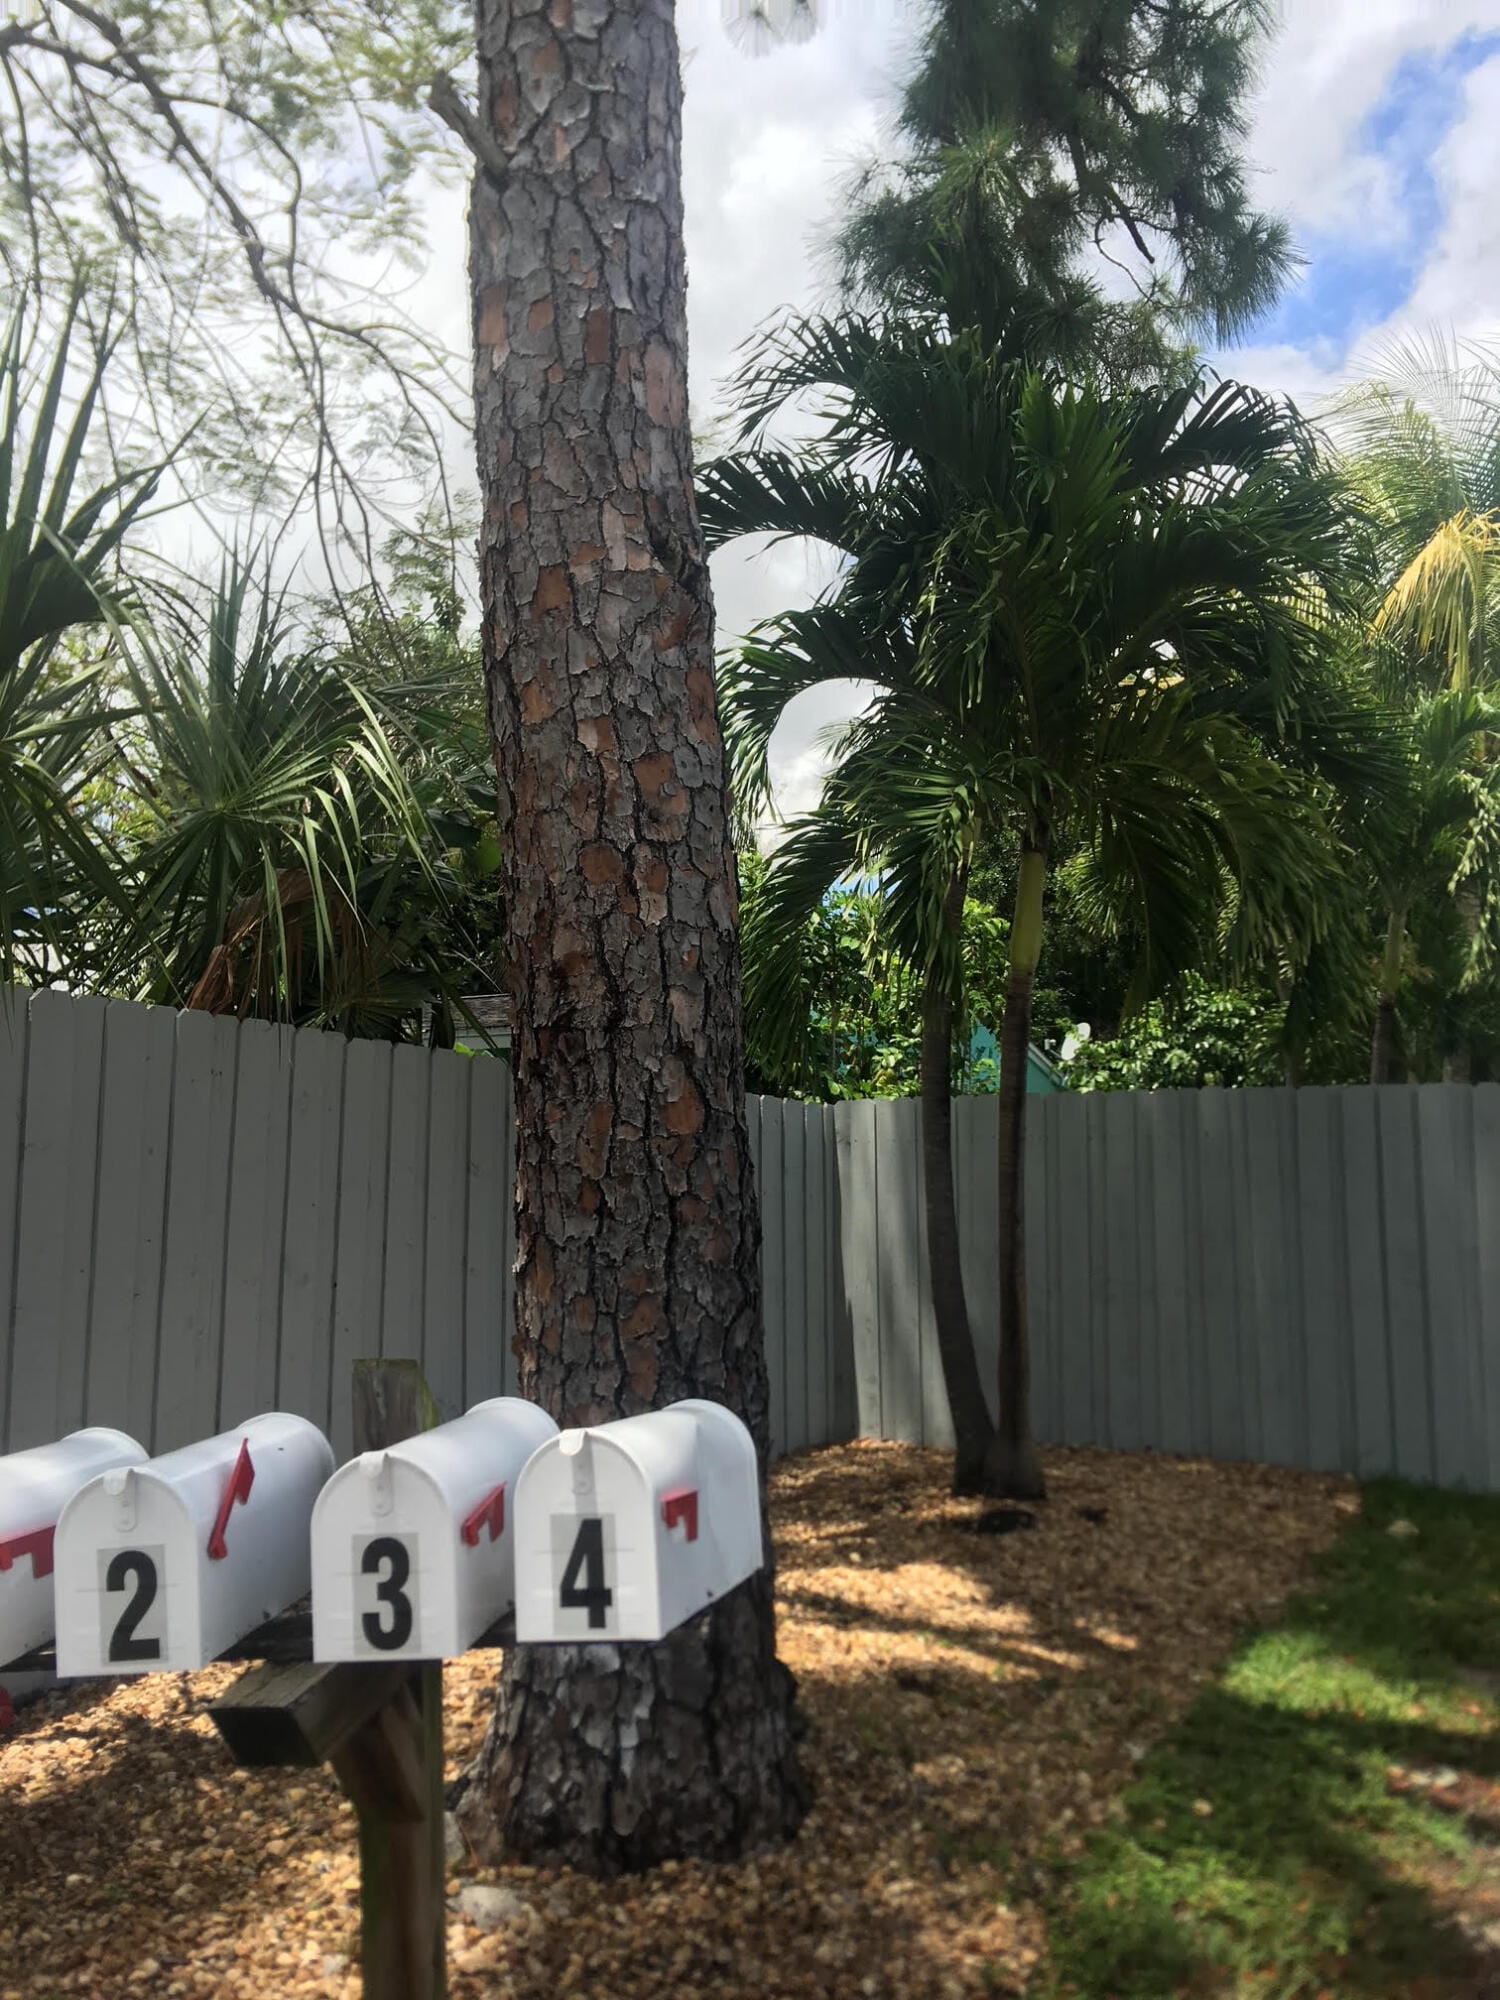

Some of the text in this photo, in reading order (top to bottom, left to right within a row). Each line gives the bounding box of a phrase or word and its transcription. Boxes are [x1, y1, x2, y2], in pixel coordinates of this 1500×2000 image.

[106, 1550, 160, 1662] 2
[361, 1537, 413, 1651] 3
[560, 1518, 612, 1629] 4
